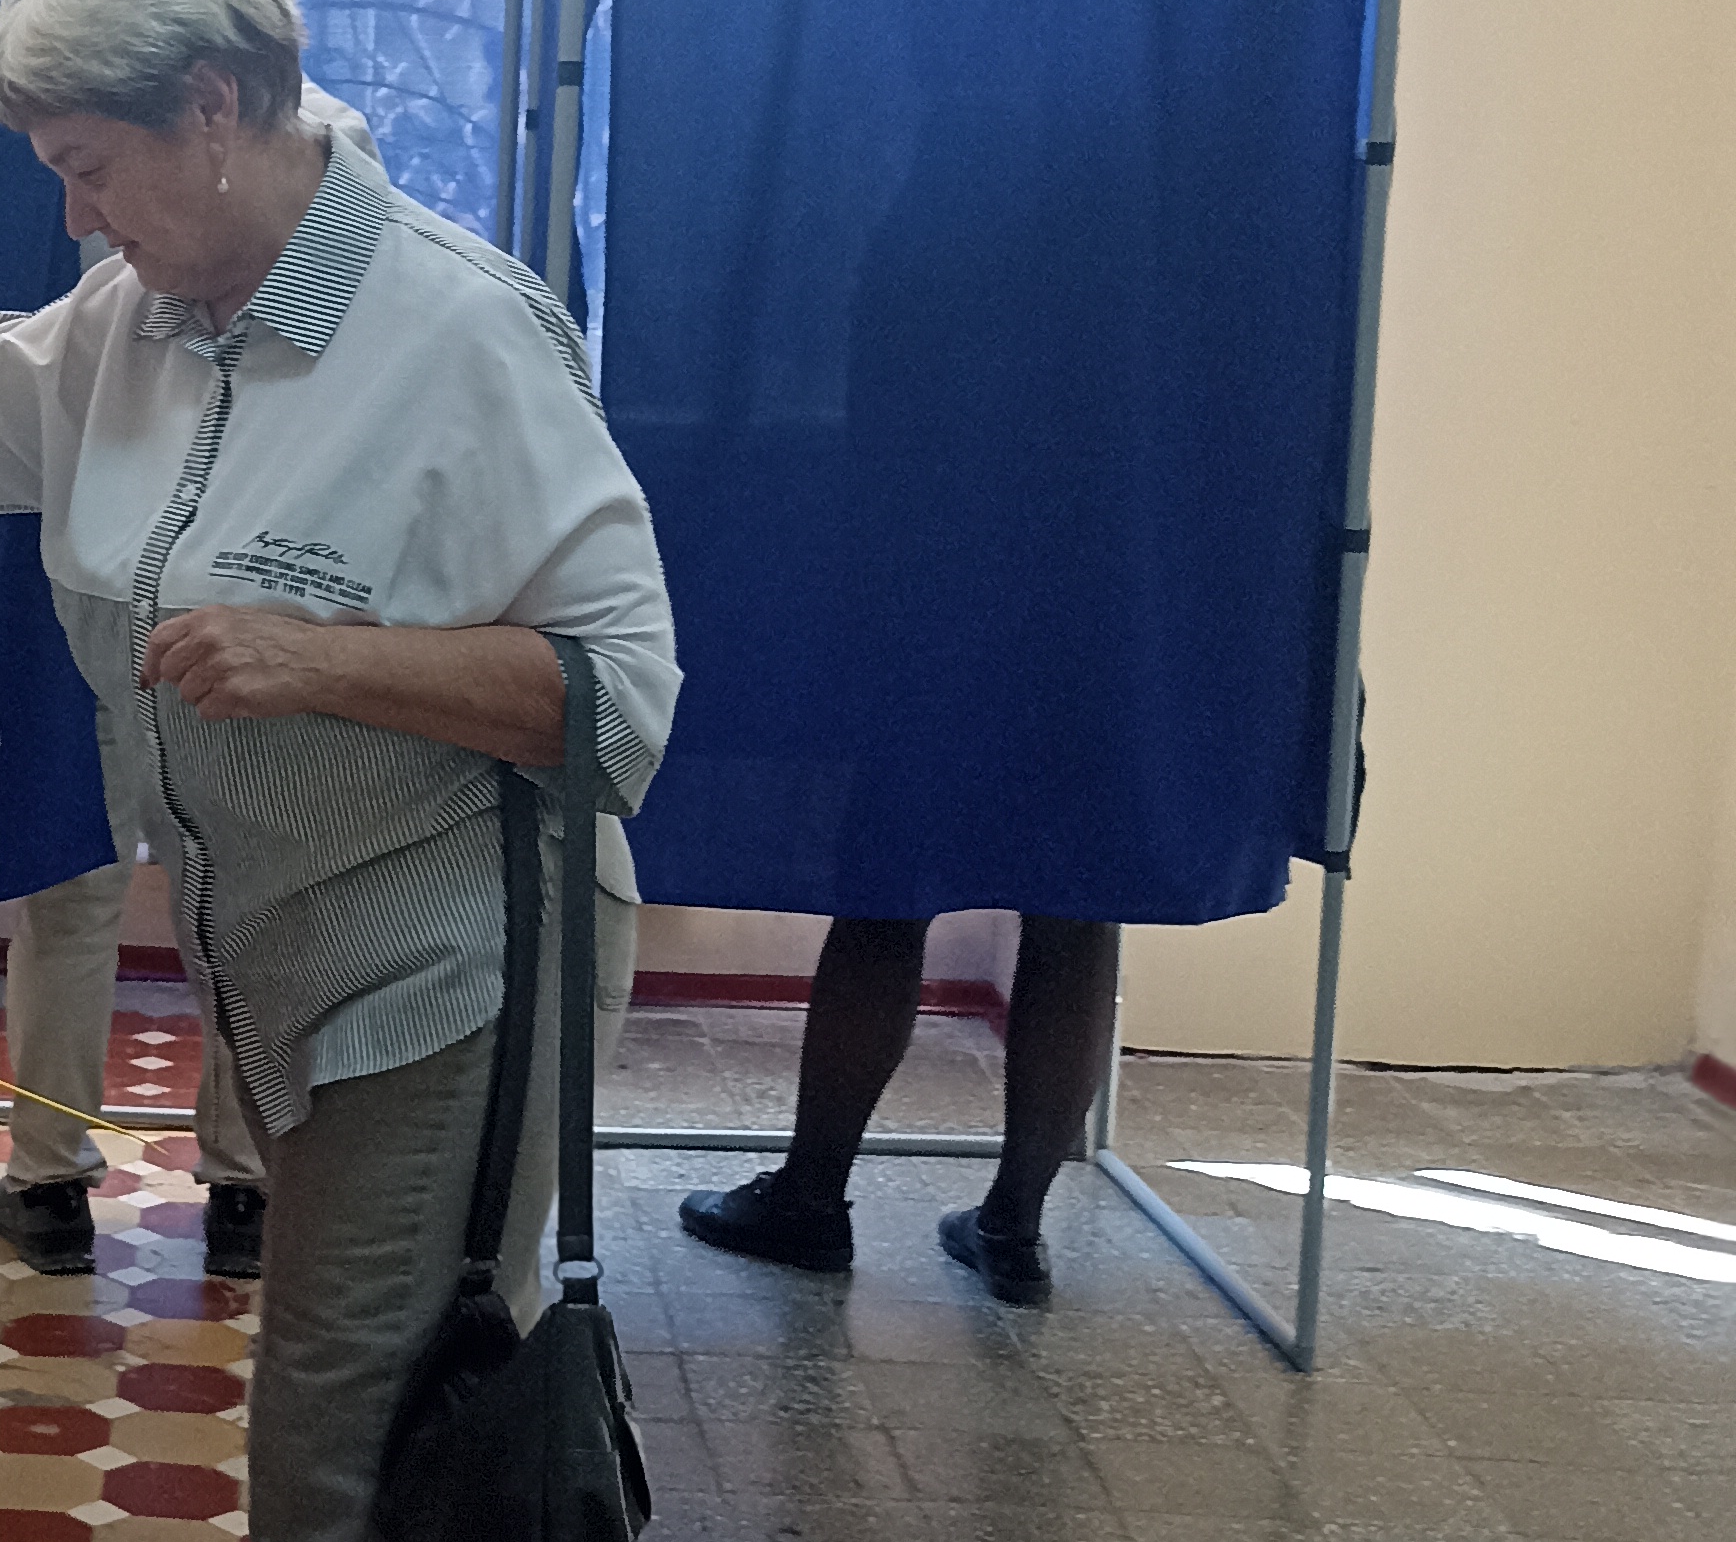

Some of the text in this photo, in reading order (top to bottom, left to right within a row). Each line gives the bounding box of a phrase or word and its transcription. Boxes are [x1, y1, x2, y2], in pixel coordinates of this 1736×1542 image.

[260, 577, 280, 591] EST
[328, 574, 346, 585] AND
[346, 579, 373, 595] CLEAN
